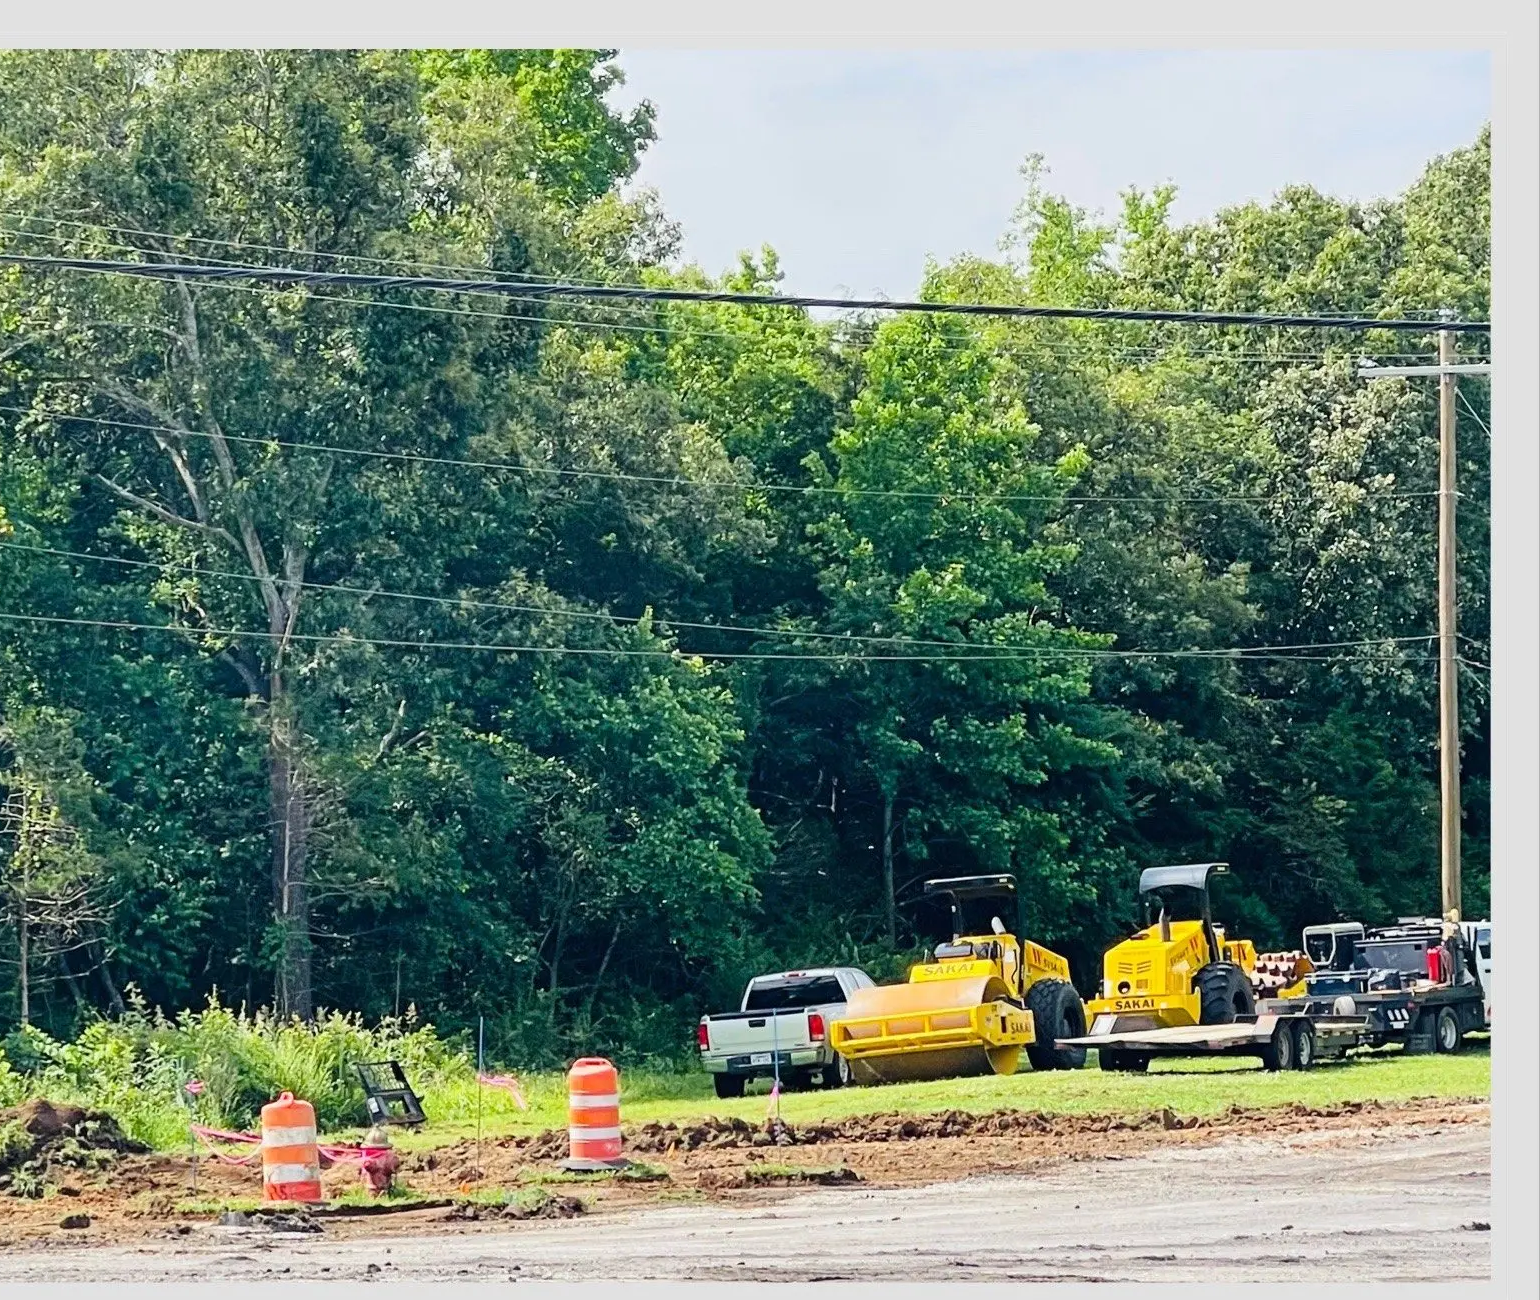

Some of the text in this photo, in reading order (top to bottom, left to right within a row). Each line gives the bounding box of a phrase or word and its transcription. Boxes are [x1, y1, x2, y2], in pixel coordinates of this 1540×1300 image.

[923, 963, 975, 977] SAKAI
[1115, 999, 1155, 1011] SAKAI
[1011, 1022, 1032, 1035] SAKAI
